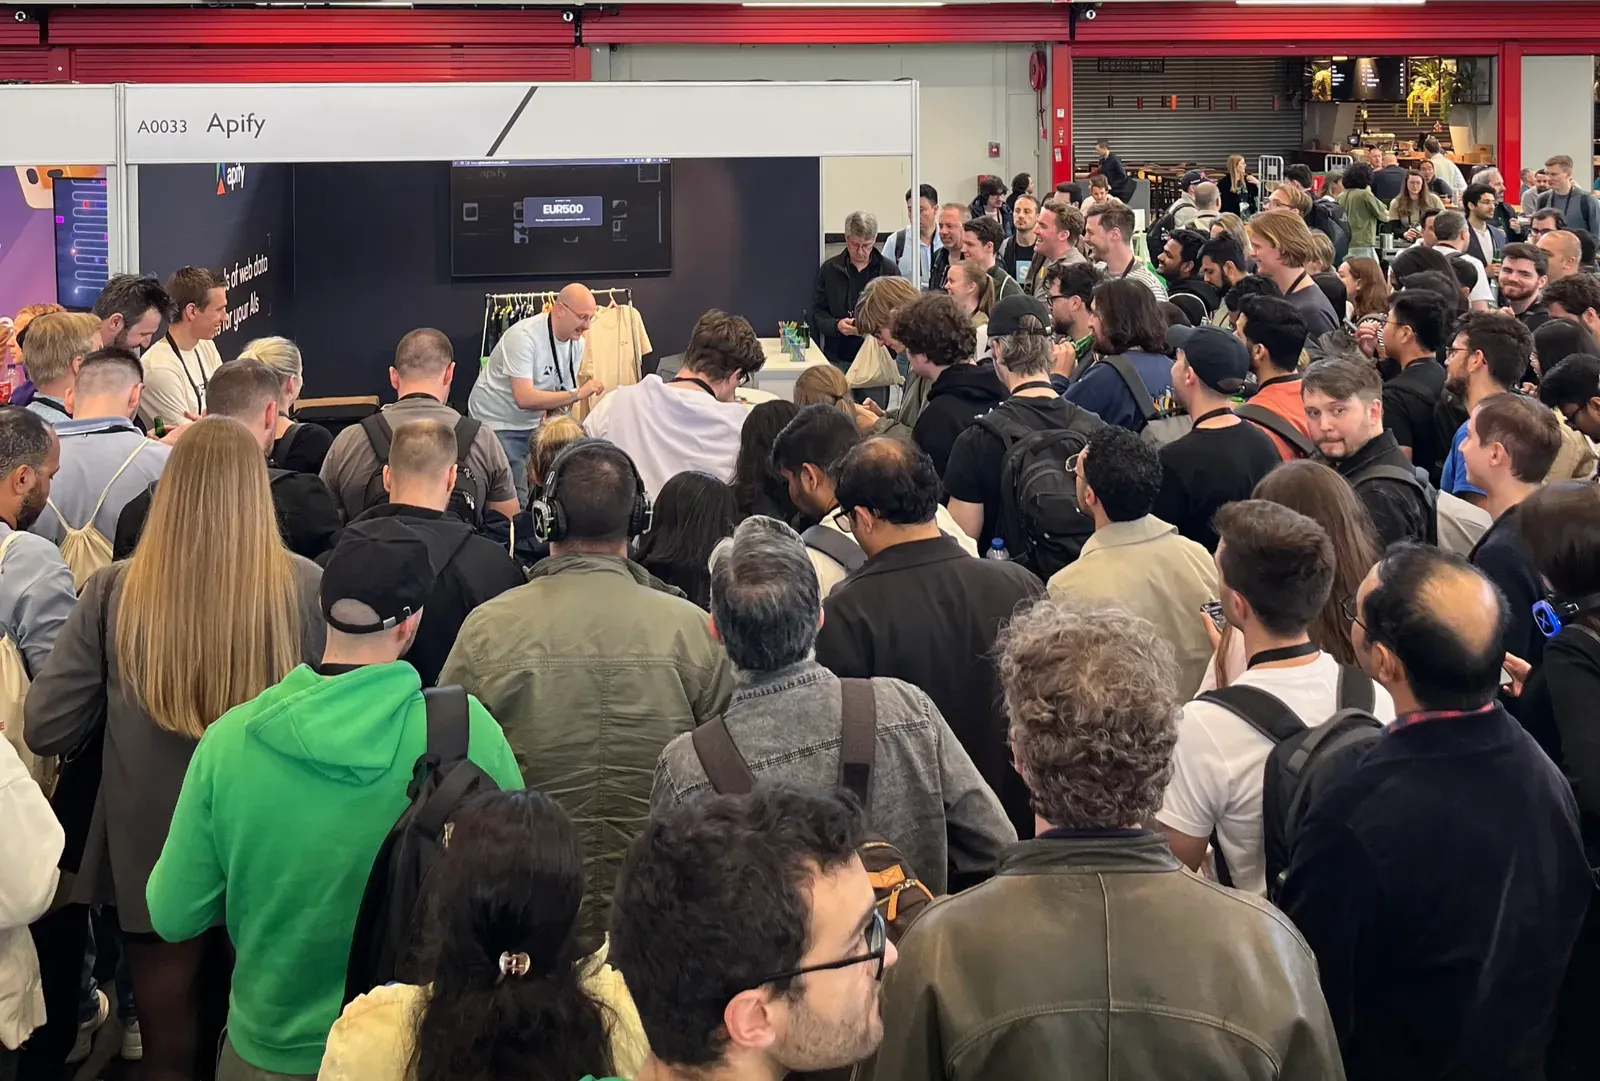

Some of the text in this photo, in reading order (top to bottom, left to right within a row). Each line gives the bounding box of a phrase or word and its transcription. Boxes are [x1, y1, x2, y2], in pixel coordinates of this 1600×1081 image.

[136, 112, 266, 139] A0033 Apify
[226, 161, 246, 191] apify
[542, 203, 584, 215] EUR500
[230, 261, 239, 288] of
[239, 257, 253, 284] web
[253, 253, 268, 277] data
[233, 301, 249, 332] your
